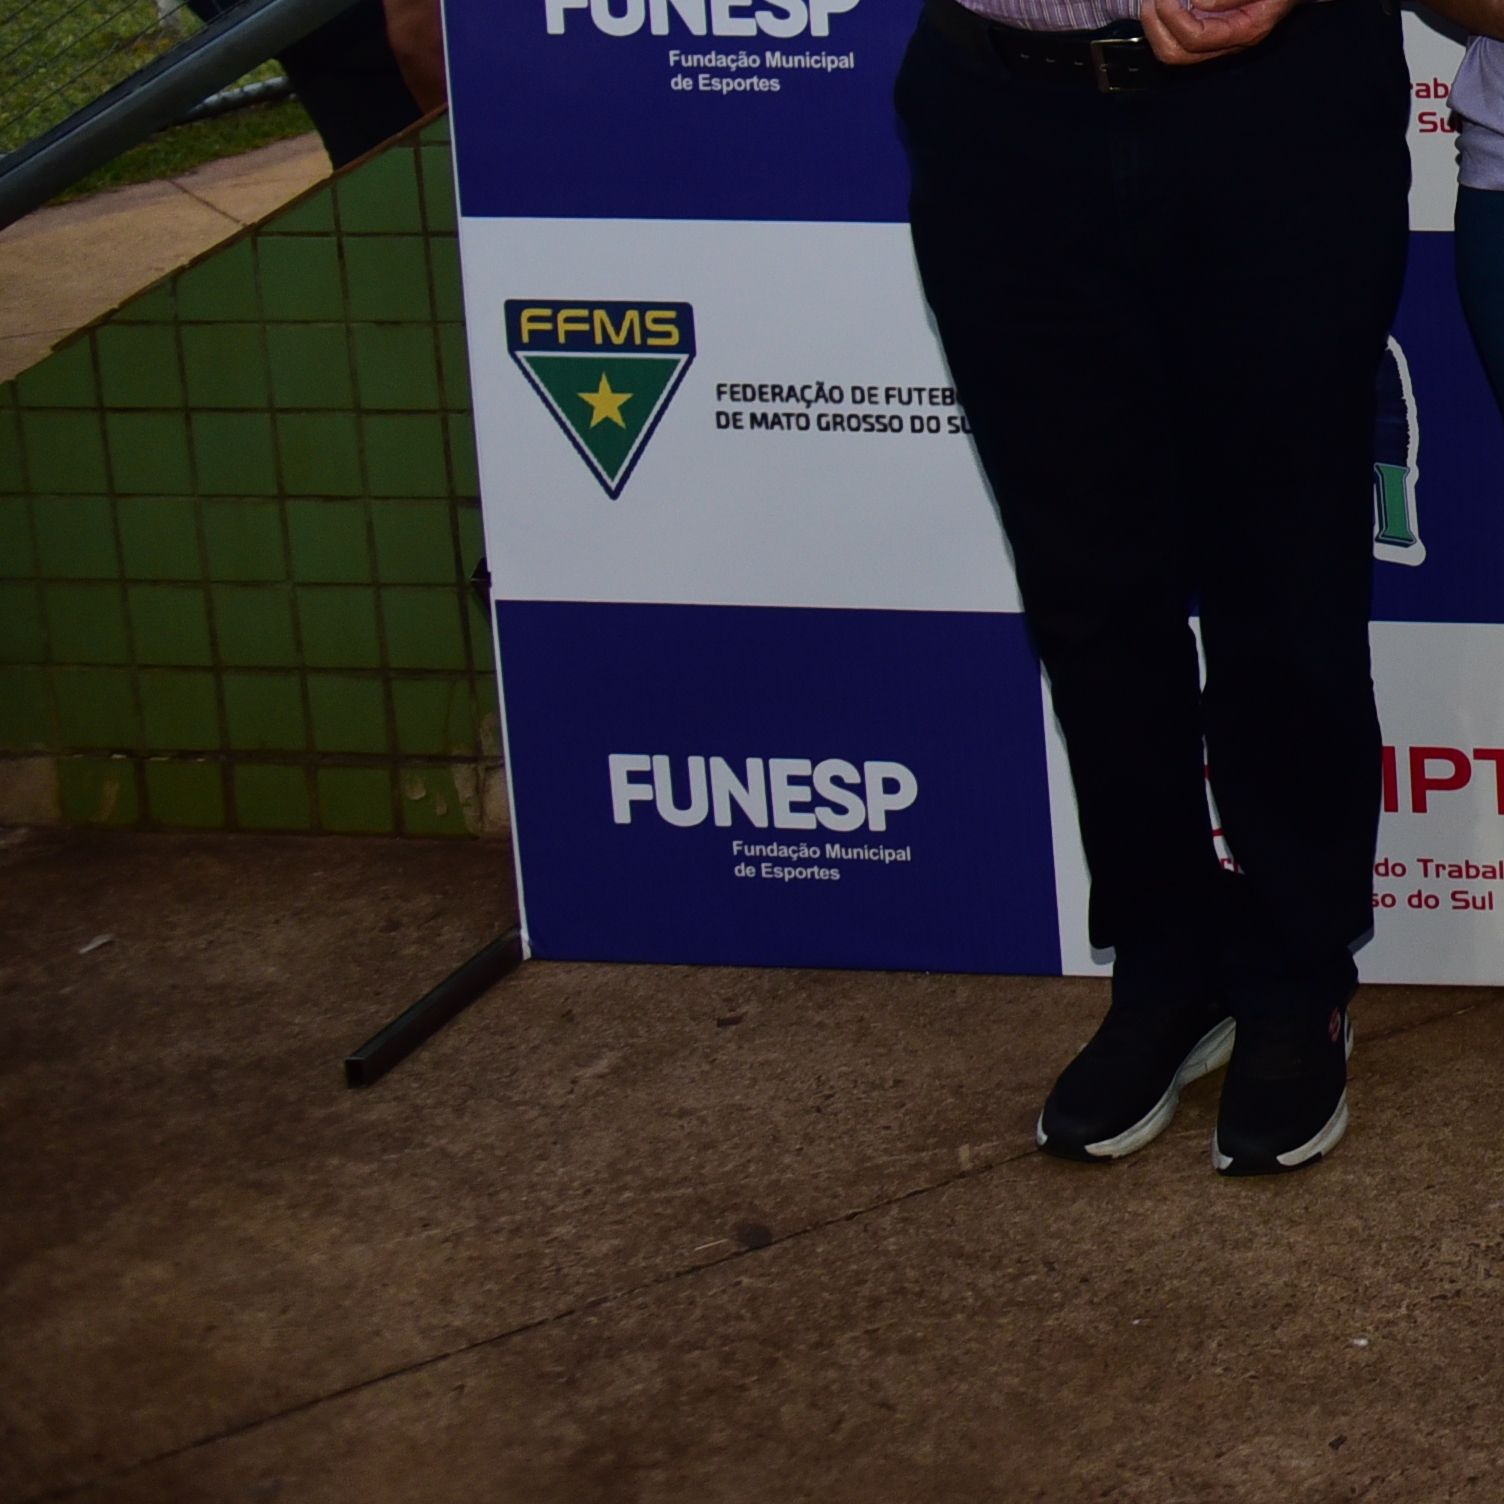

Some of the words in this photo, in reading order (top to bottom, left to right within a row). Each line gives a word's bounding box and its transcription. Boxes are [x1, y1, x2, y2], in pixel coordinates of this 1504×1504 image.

[669, 50, 760, 71] Fundação
[765, 51, 854, 71] Municipal
[671, 74, 692, 90] de
[699, 74, 780, 94] Esportes
[520, 308, 680, 346] FFMS
[716, 381, 844, 408] FEDERAÇÃO
[851, 386, 879, 405] DE
[885, 387, 956, 406] FUTEB
[716, 411, 743, 429] DE
[749, 412, 809, 431] MATO
[817, 413, 903, 433] GROSSO
[911, 415, 941, 433] DO
[948, 416, 973, 434] SU
[609, 754, 918, 831] FUNESP
[732, 841, 820, 861] Fundação
[826, 843, 911, 864] Municipal
[735, 863, 755, 877] de
[761, 863, 840, 882] Esportes
[1374, 858, 1407, 878] do
[1407, 889, 1440, 909] do
[1450, 891, 1494, 910] Sul
